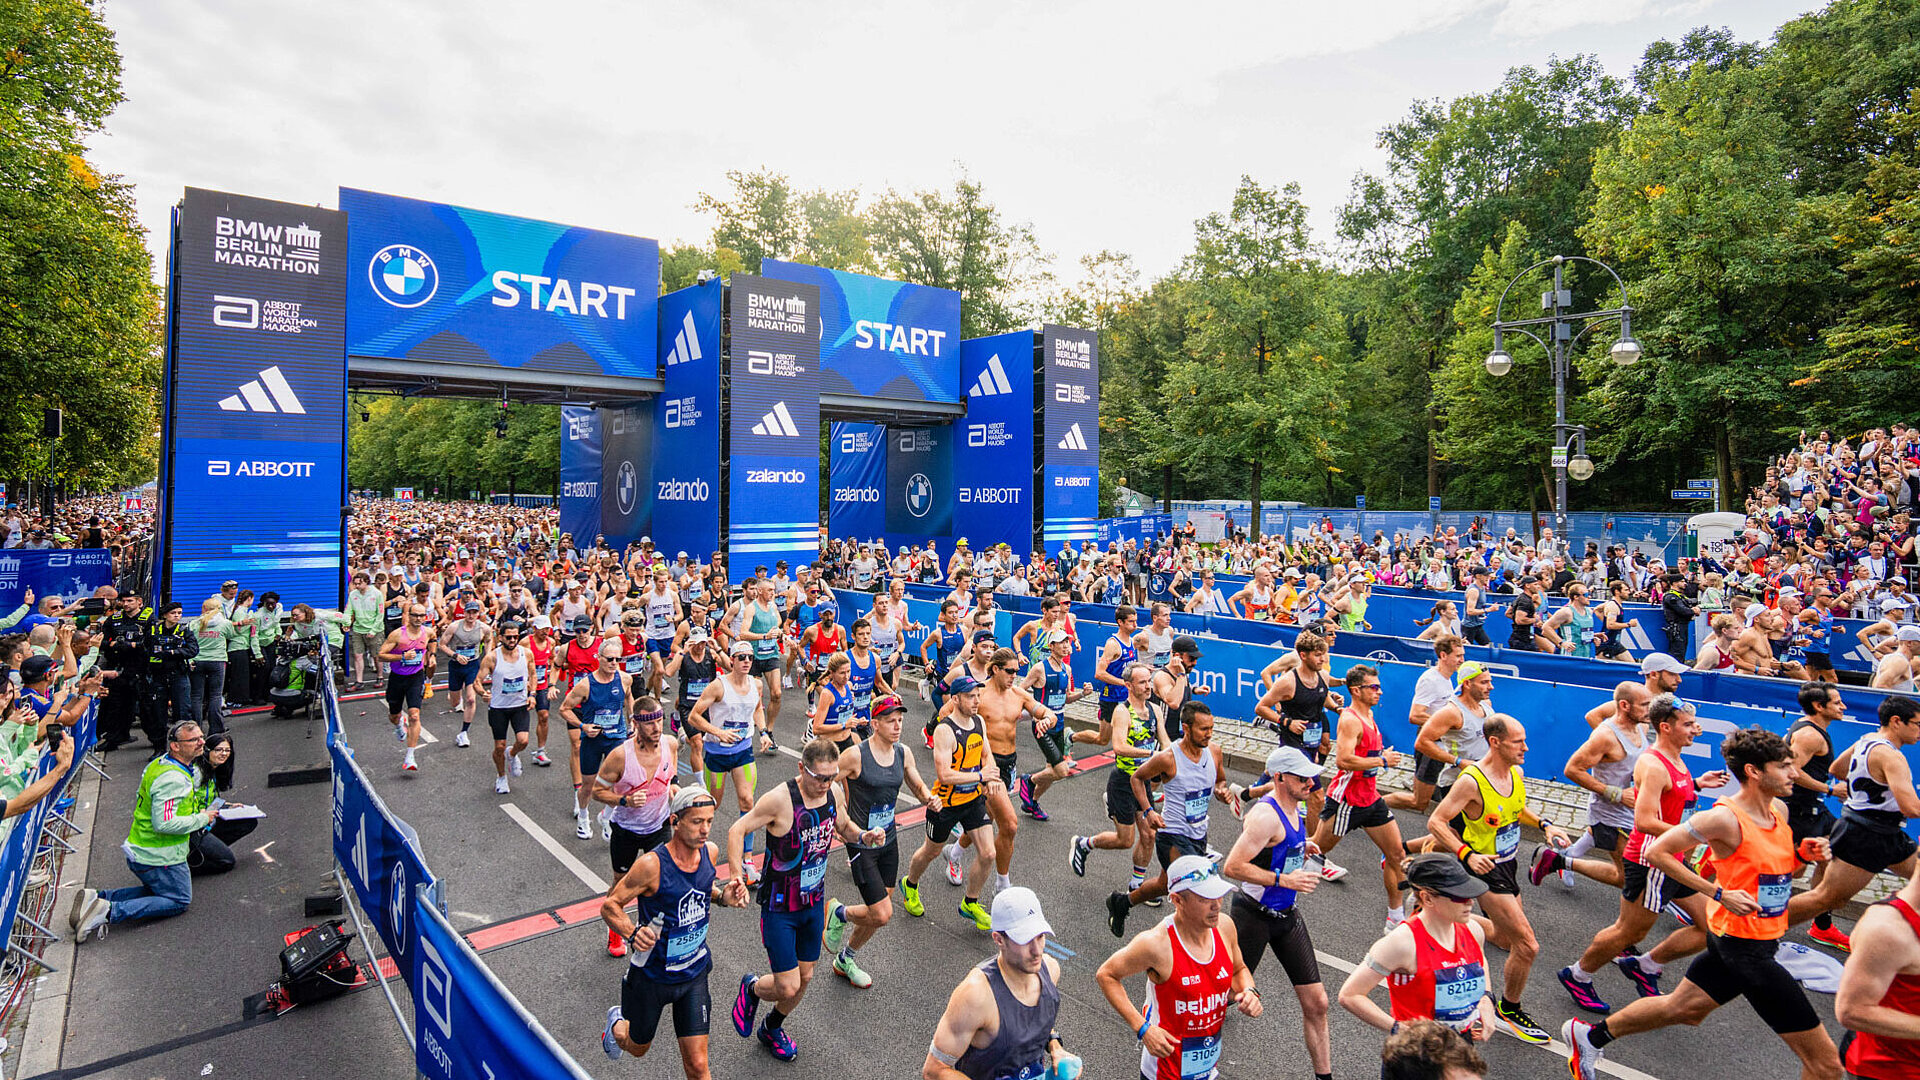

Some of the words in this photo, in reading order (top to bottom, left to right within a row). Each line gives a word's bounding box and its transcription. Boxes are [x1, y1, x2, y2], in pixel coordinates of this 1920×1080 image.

[216, 216, 282, 242] BMW
[215, 236, 283, 256] BERLIN
[214, 250, 319, 275] MARATHON
[379, 248, 430, 268] BMW
[492, 270, 636, 320] START
[748, 293, 785, 311] BMW
[263, 300, 302, 311] ABBOTT
[263, 308, 299, 318] WORLD
[262, 316, 317, 328] MARATHON
[748, 308, 785, 321] BERLIN
[262, 322, 301, 333] MAJORS
[748, 318, 806, 334] MARATHON
[855, 320, 946, 357] START
[1055, 338, 1078, 351] BMW
[1055, 351, 1078, 360] BERLIN
[1055, 360, 1090, 370] MARATHON
[682, 396, 696, 404] ABBOTT
[682, 410, 702, 419] MARATHON
[235, 461, 315, 477] ABBOTT
[746, 468, 805, 483] zalando
[1064, 477, 1091, 487] ABBOTT
[572, 482, 598, 498] ABBOTT
[658, 478, 709, 502] zalando
[835, 486, 880, 502] zalando
[974, 488, 1022, 503] ABBOTT
[1448, 980, 1478, 995] 82123
[424, 1027, 452, 1078] ABBOTT
